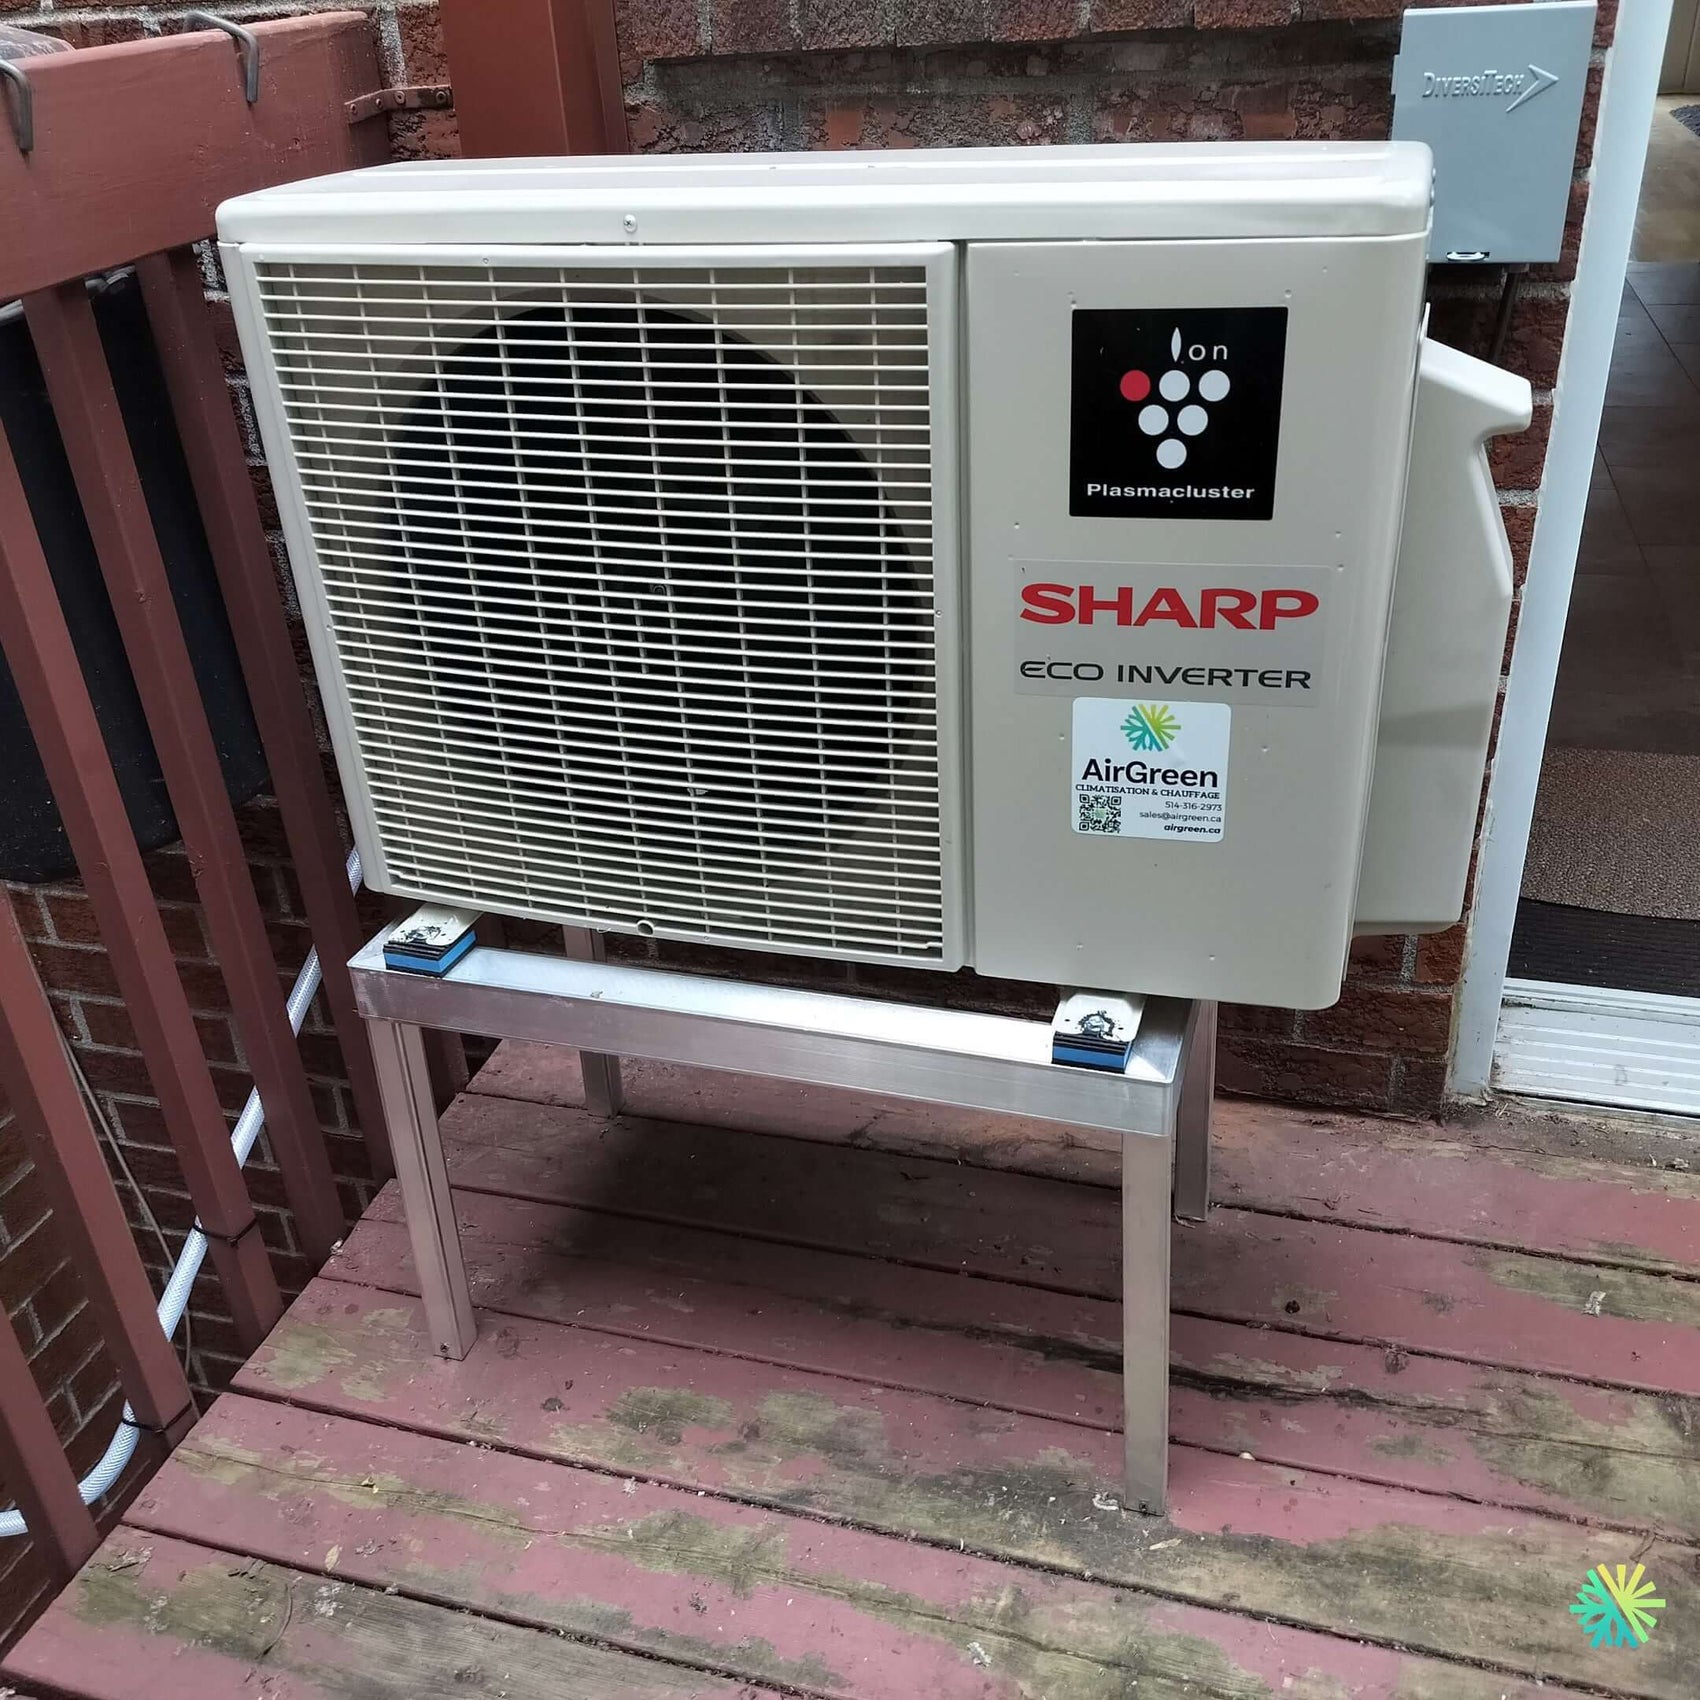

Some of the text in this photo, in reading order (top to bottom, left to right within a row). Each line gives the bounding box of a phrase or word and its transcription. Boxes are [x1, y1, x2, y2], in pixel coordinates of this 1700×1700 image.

[1087, 483, 1255, 499] Plasmacluster
[1020, 583, 1319, 630] SHARP
[1020, 661, 1311, 689] ECO INVERTER
[1082, 758, 1218, 788] AirGreen
[1075, 784, 1220, 799] CLIMATISATION & CHAUFFAGE
[1165, 801, 1222, 811] 514-316-2973
[1139, 811, 1222, 823] sales@airgreen.ca
[1164, 823, 1221, 834] airgreen.ca
